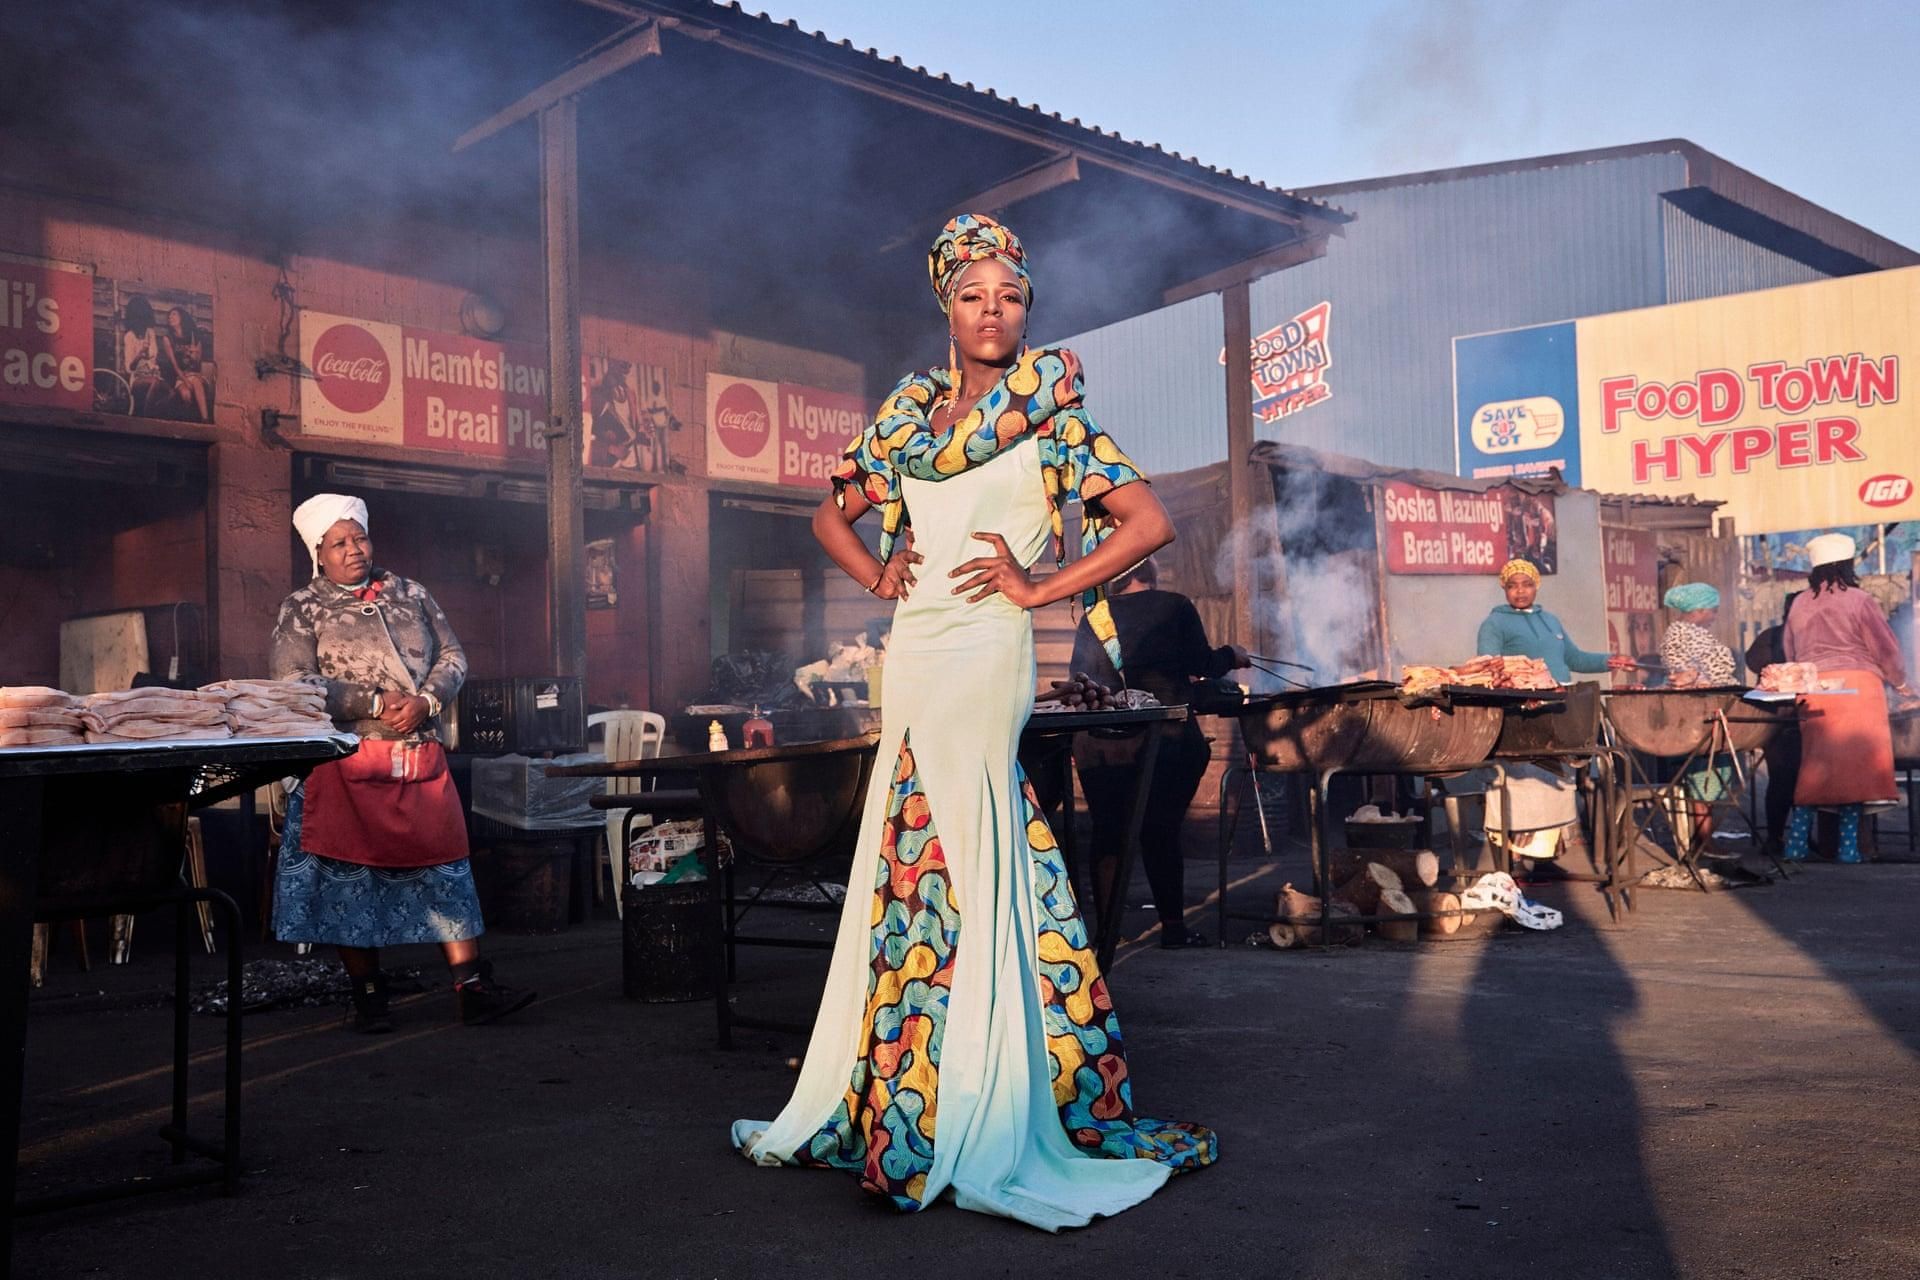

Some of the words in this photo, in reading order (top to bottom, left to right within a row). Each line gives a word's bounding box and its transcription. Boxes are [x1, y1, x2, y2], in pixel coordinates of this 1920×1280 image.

[1250, 319, 1305, 360] OOD
[1255, 343, 1324, 385] TOWN
[1261, 384, 1328, 422] HYPER
[1601, 368, 1744, 433] FOOD
[1747, 353, 1898, 415] TOWN
[427, 396, 498, 444] Braai
[1481, 405, 1526, 423] SAVE
[1486, 434, 1522, 448] LOT
[1631, 416, 1867, 484] HYPER
[1385, 488, 1438, 522] Sosha
[1863, 479, 1908, 502] IGA
[1403, 531, 1448, 564] Braai
[1451, 532, 1494, 565] Place
[1623, 575, 1657, 609] Place
